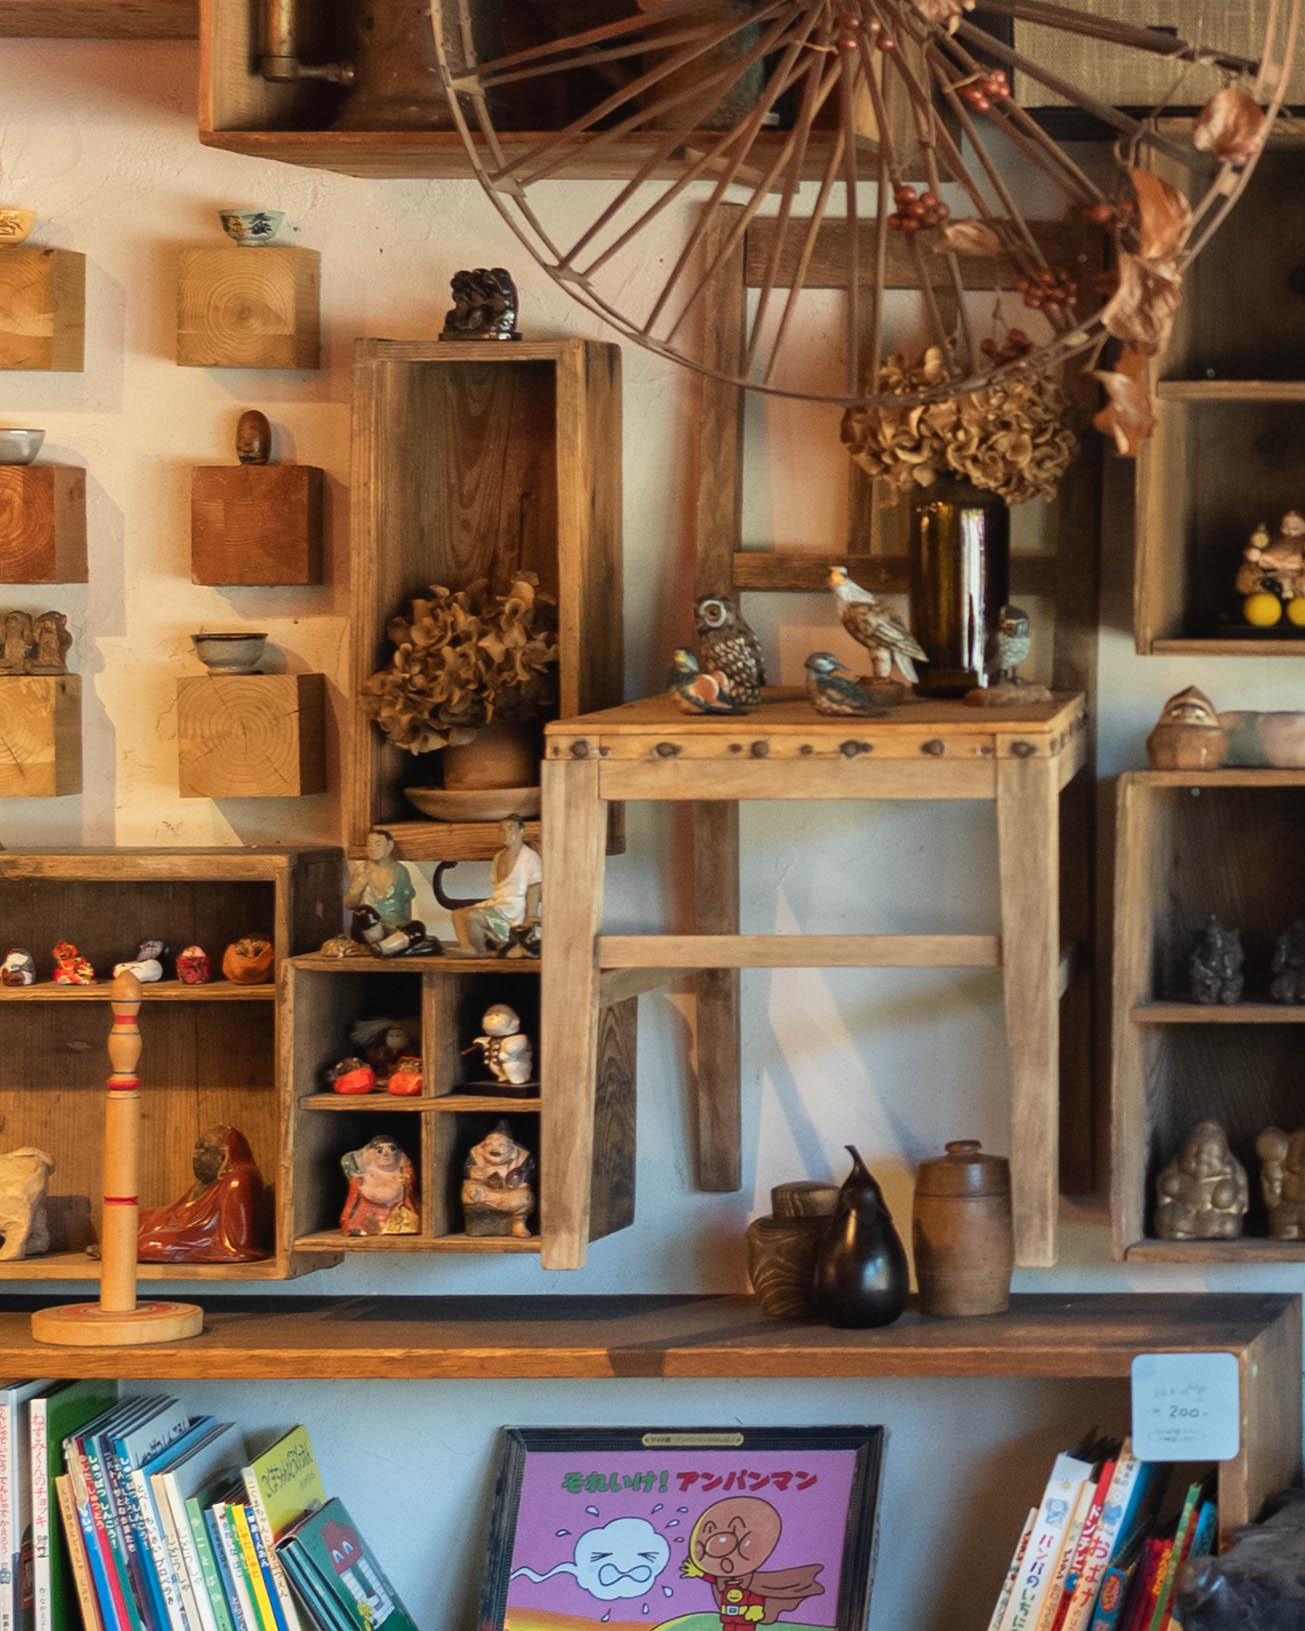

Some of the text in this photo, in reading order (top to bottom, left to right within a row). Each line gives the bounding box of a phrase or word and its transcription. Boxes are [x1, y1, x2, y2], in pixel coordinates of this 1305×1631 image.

[562, 1470, 819, 1494] それいけ! アンパンマン
